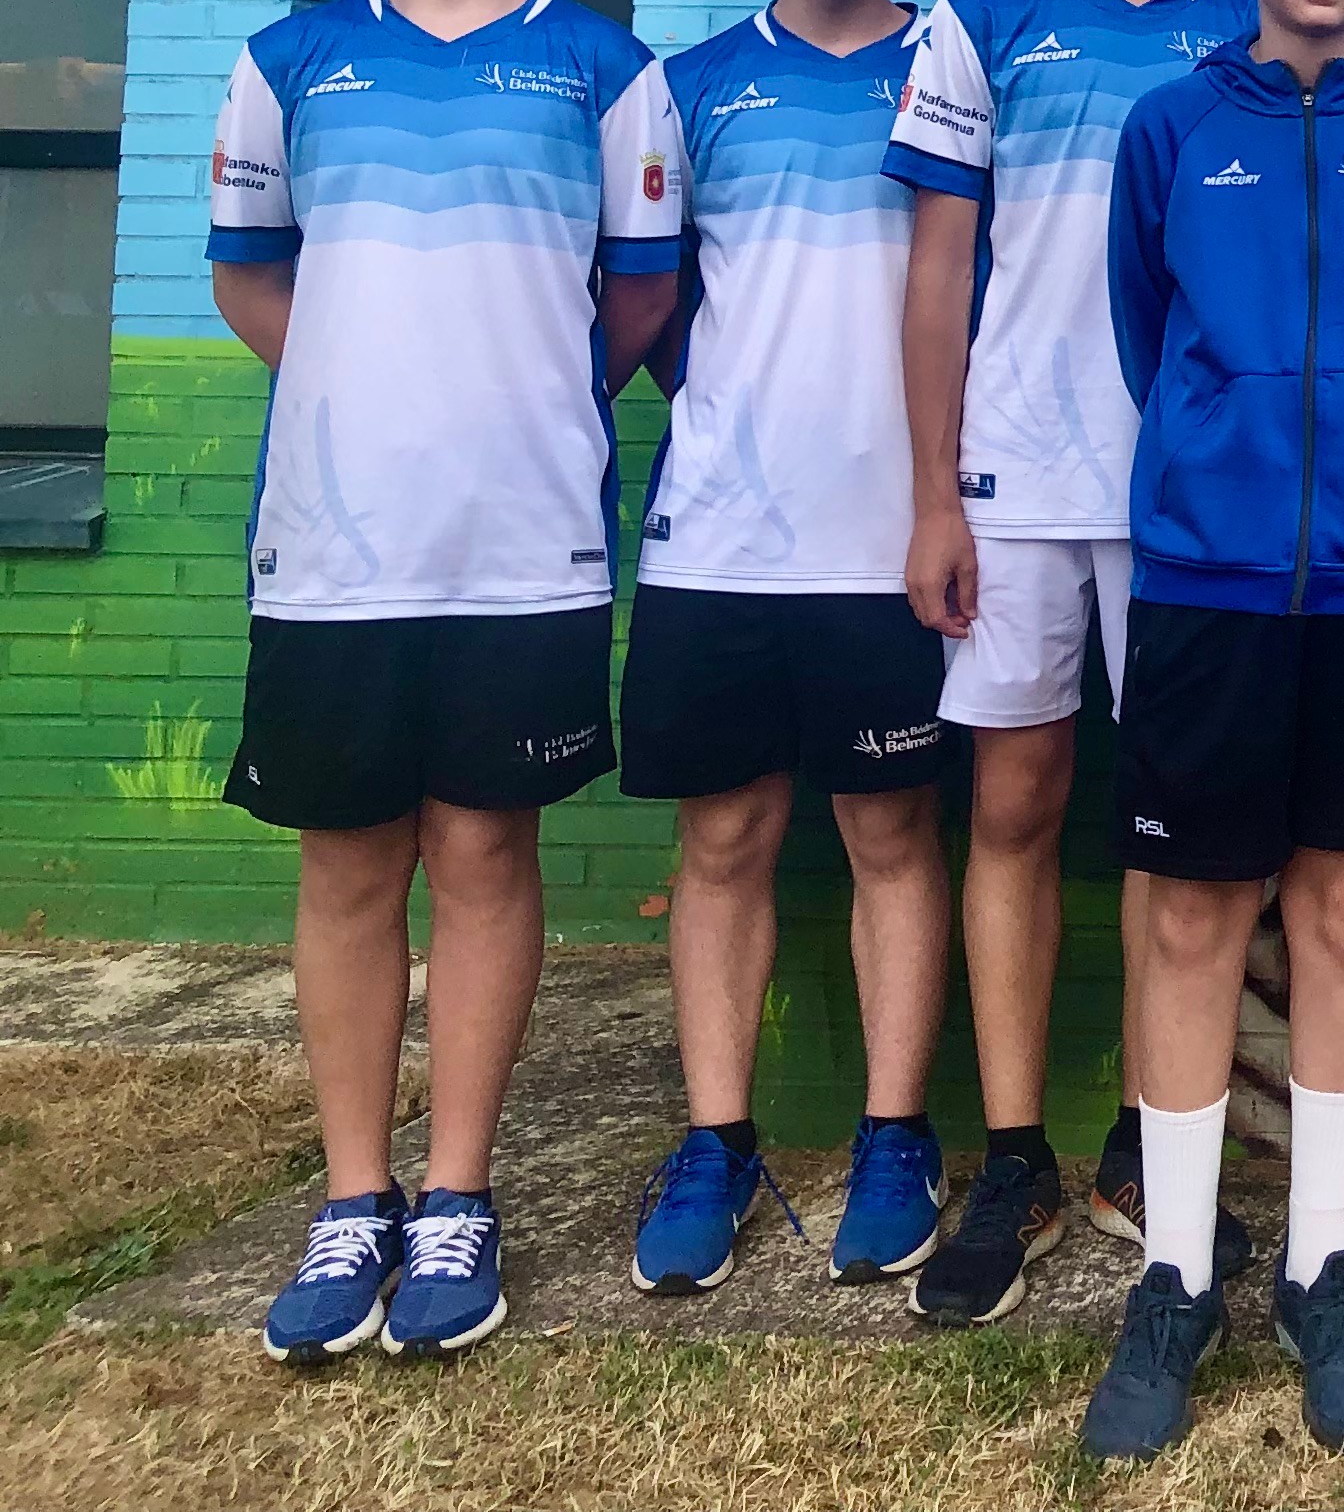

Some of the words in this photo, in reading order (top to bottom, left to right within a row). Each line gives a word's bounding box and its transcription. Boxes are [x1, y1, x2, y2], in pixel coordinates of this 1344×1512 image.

[1012, 48, 1081, 66] MERCURY
[511, 68, 537, 79] Club
[509, 77, 587, 102] Belmecher
[918, 88, 989, 123] Nafarroako
[1202, 173, 1262, 186] MERCURY
[885, 728, 909, 740] Club
[1134, 816, 1170, 838] RSL
